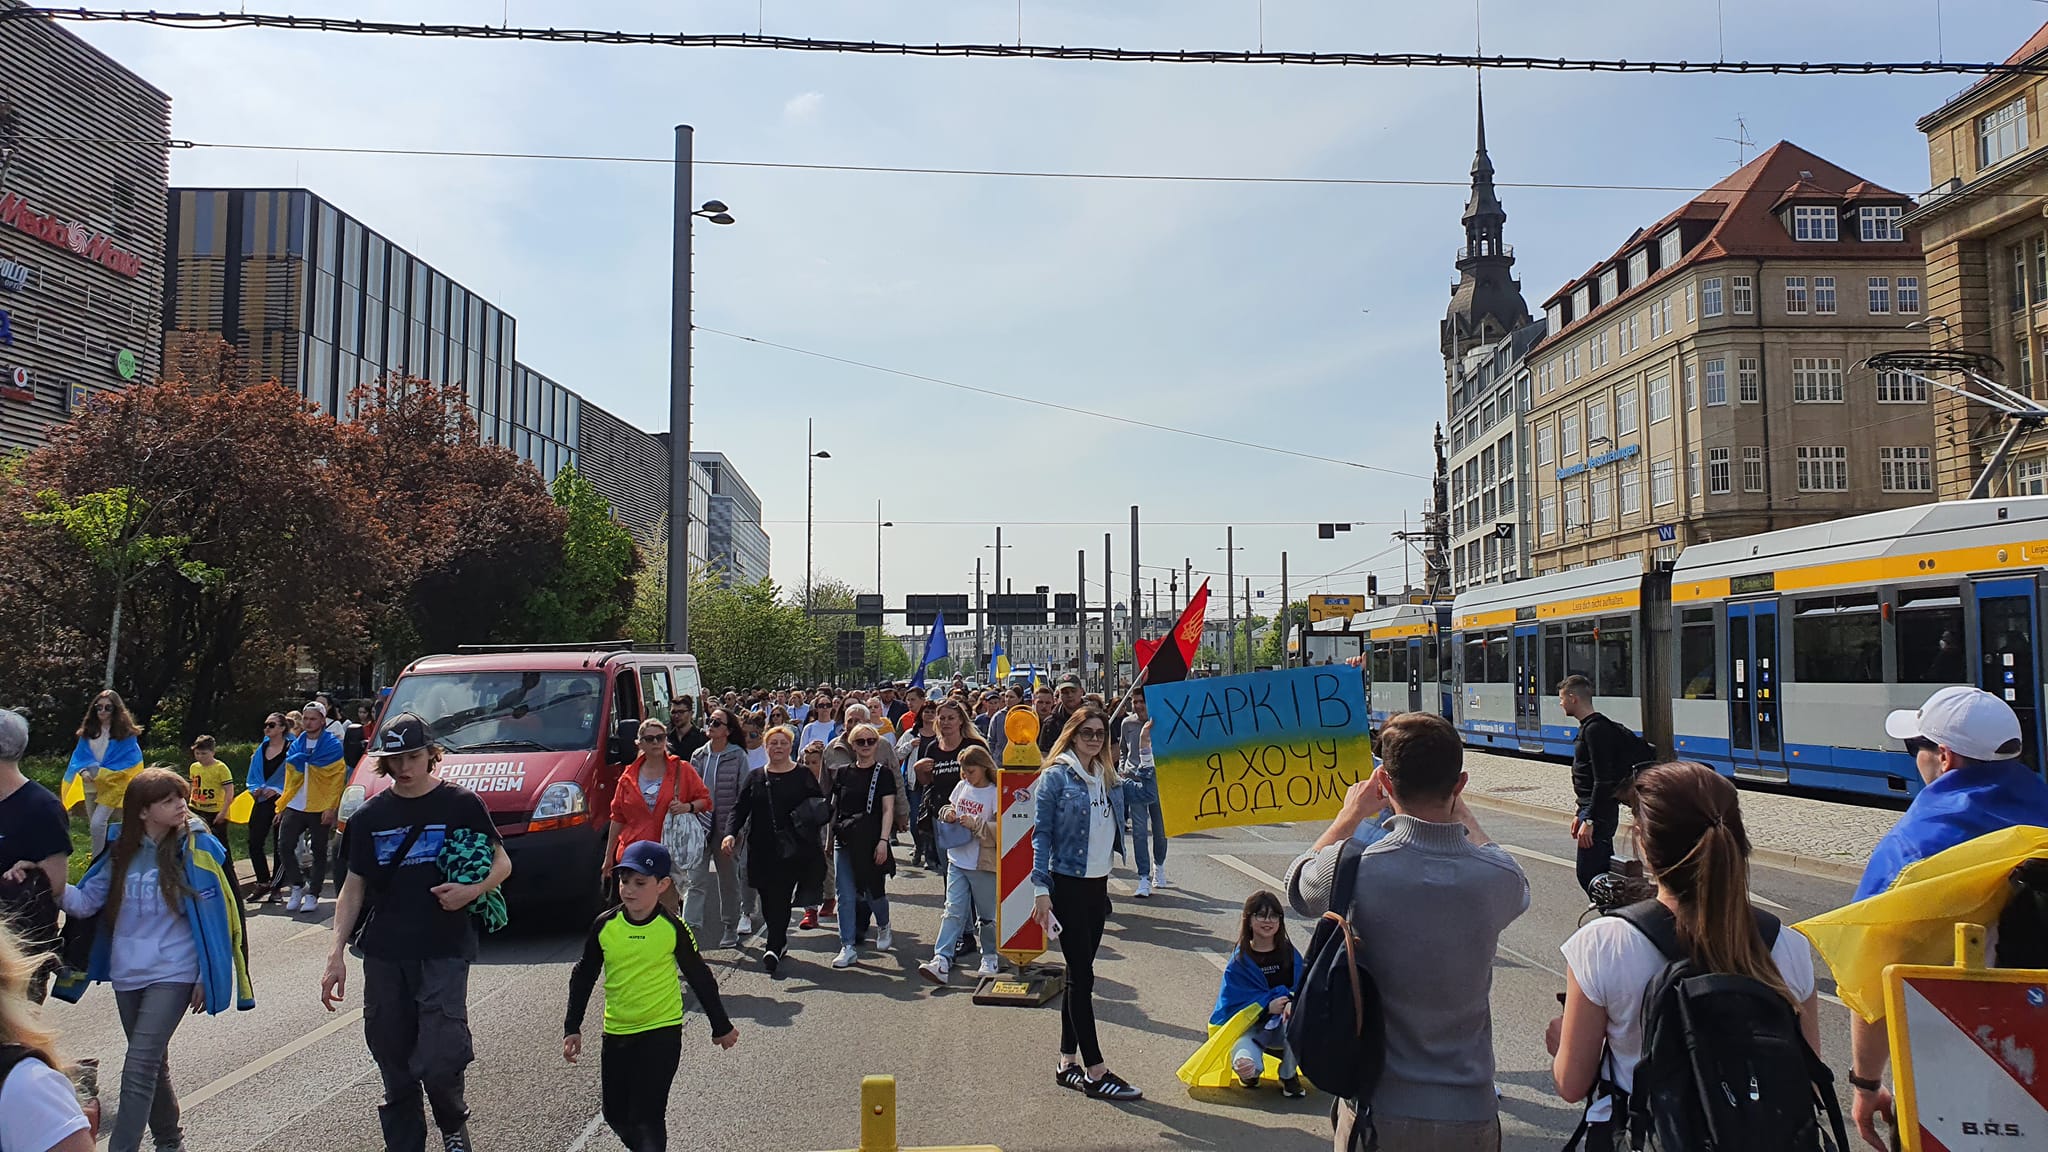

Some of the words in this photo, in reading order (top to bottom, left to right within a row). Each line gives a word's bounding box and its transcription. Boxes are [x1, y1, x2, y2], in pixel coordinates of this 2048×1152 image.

[0, 192, 69, 249] Media
[82, 232, 142, 278] Markt
[1659, 527, 1672, 539] W
[1163, 673, 1351, 745] ХАРКІВ
[438, 761, 526, 778] FOOTBALL
[1206, 752, 1225, 785] Я
[1238, 738, 1338, 781] ХОЧУ
[456, 777, 524, 792] RACISM
[1962, 1121, 2025, 1137] B.R.S.
